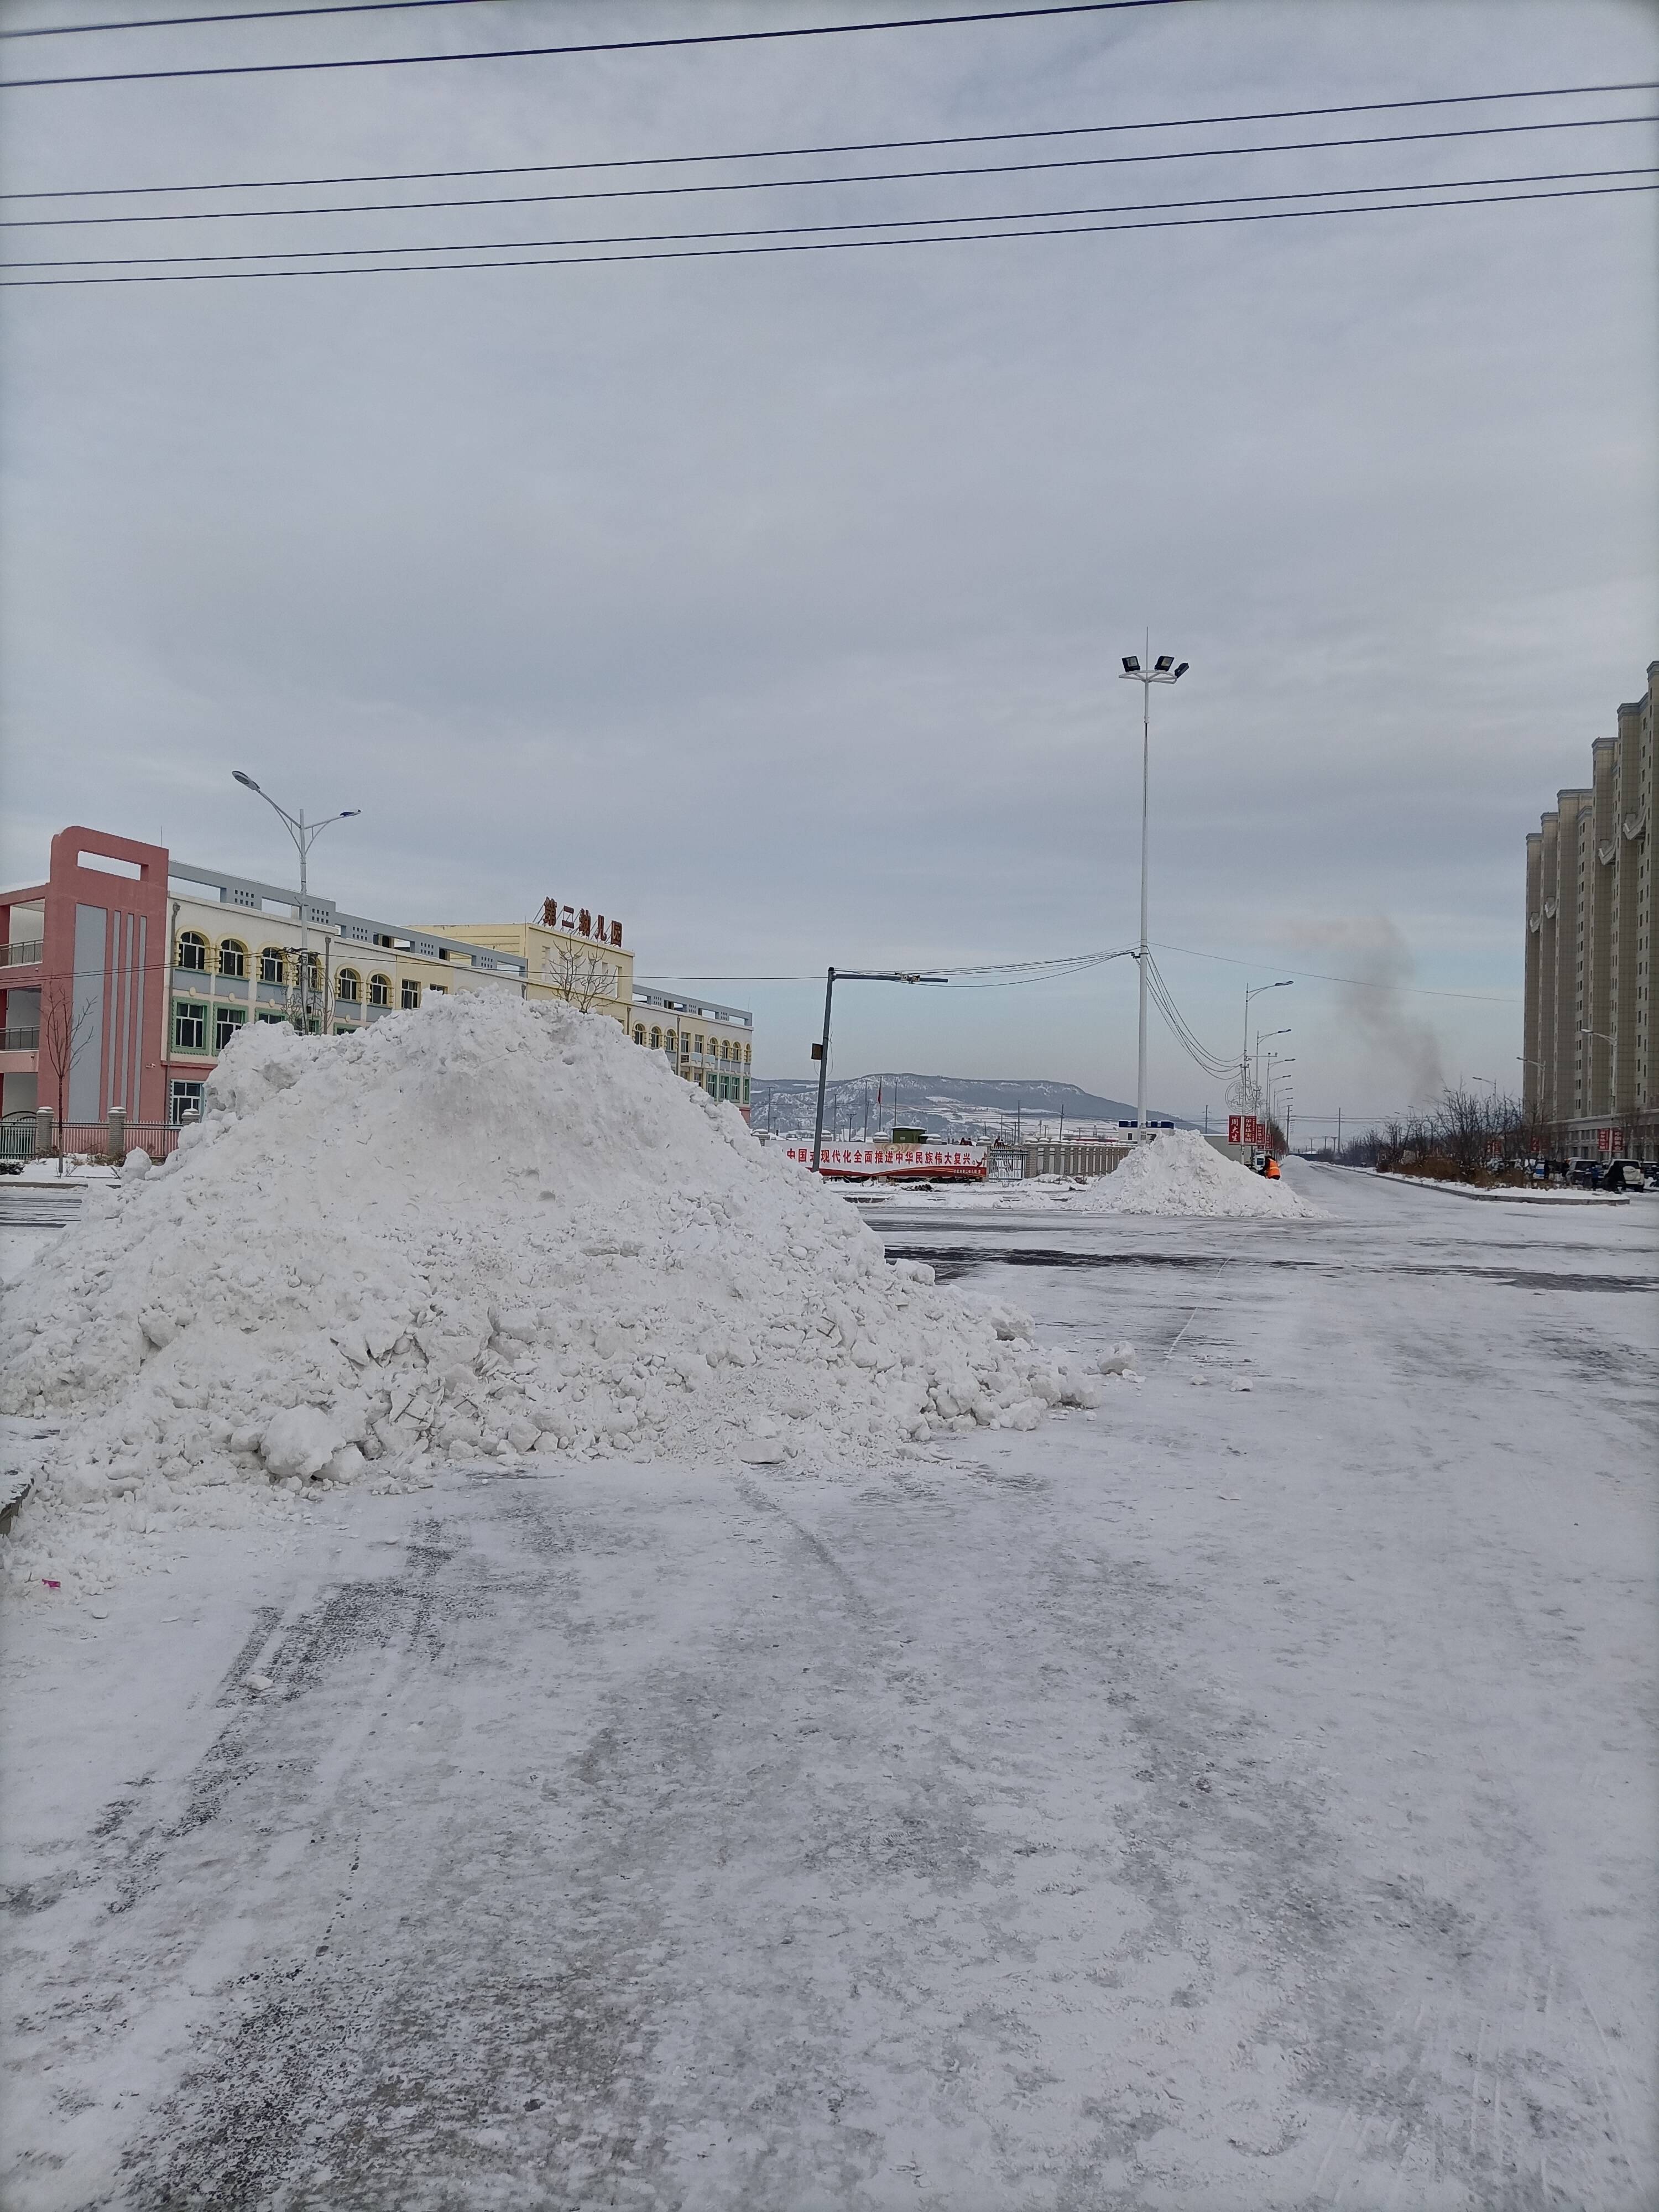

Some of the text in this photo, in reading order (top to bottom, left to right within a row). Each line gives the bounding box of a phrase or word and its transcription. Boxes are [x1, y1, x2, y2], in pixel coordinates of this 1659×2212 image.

[543, 896, 622, 947] 第二幼儿园
[1231, 1118, 1239, 1141] 周大生
[786, 1148, 971, 1165] 中国式现代化全面推进中华民族伟大复兴
